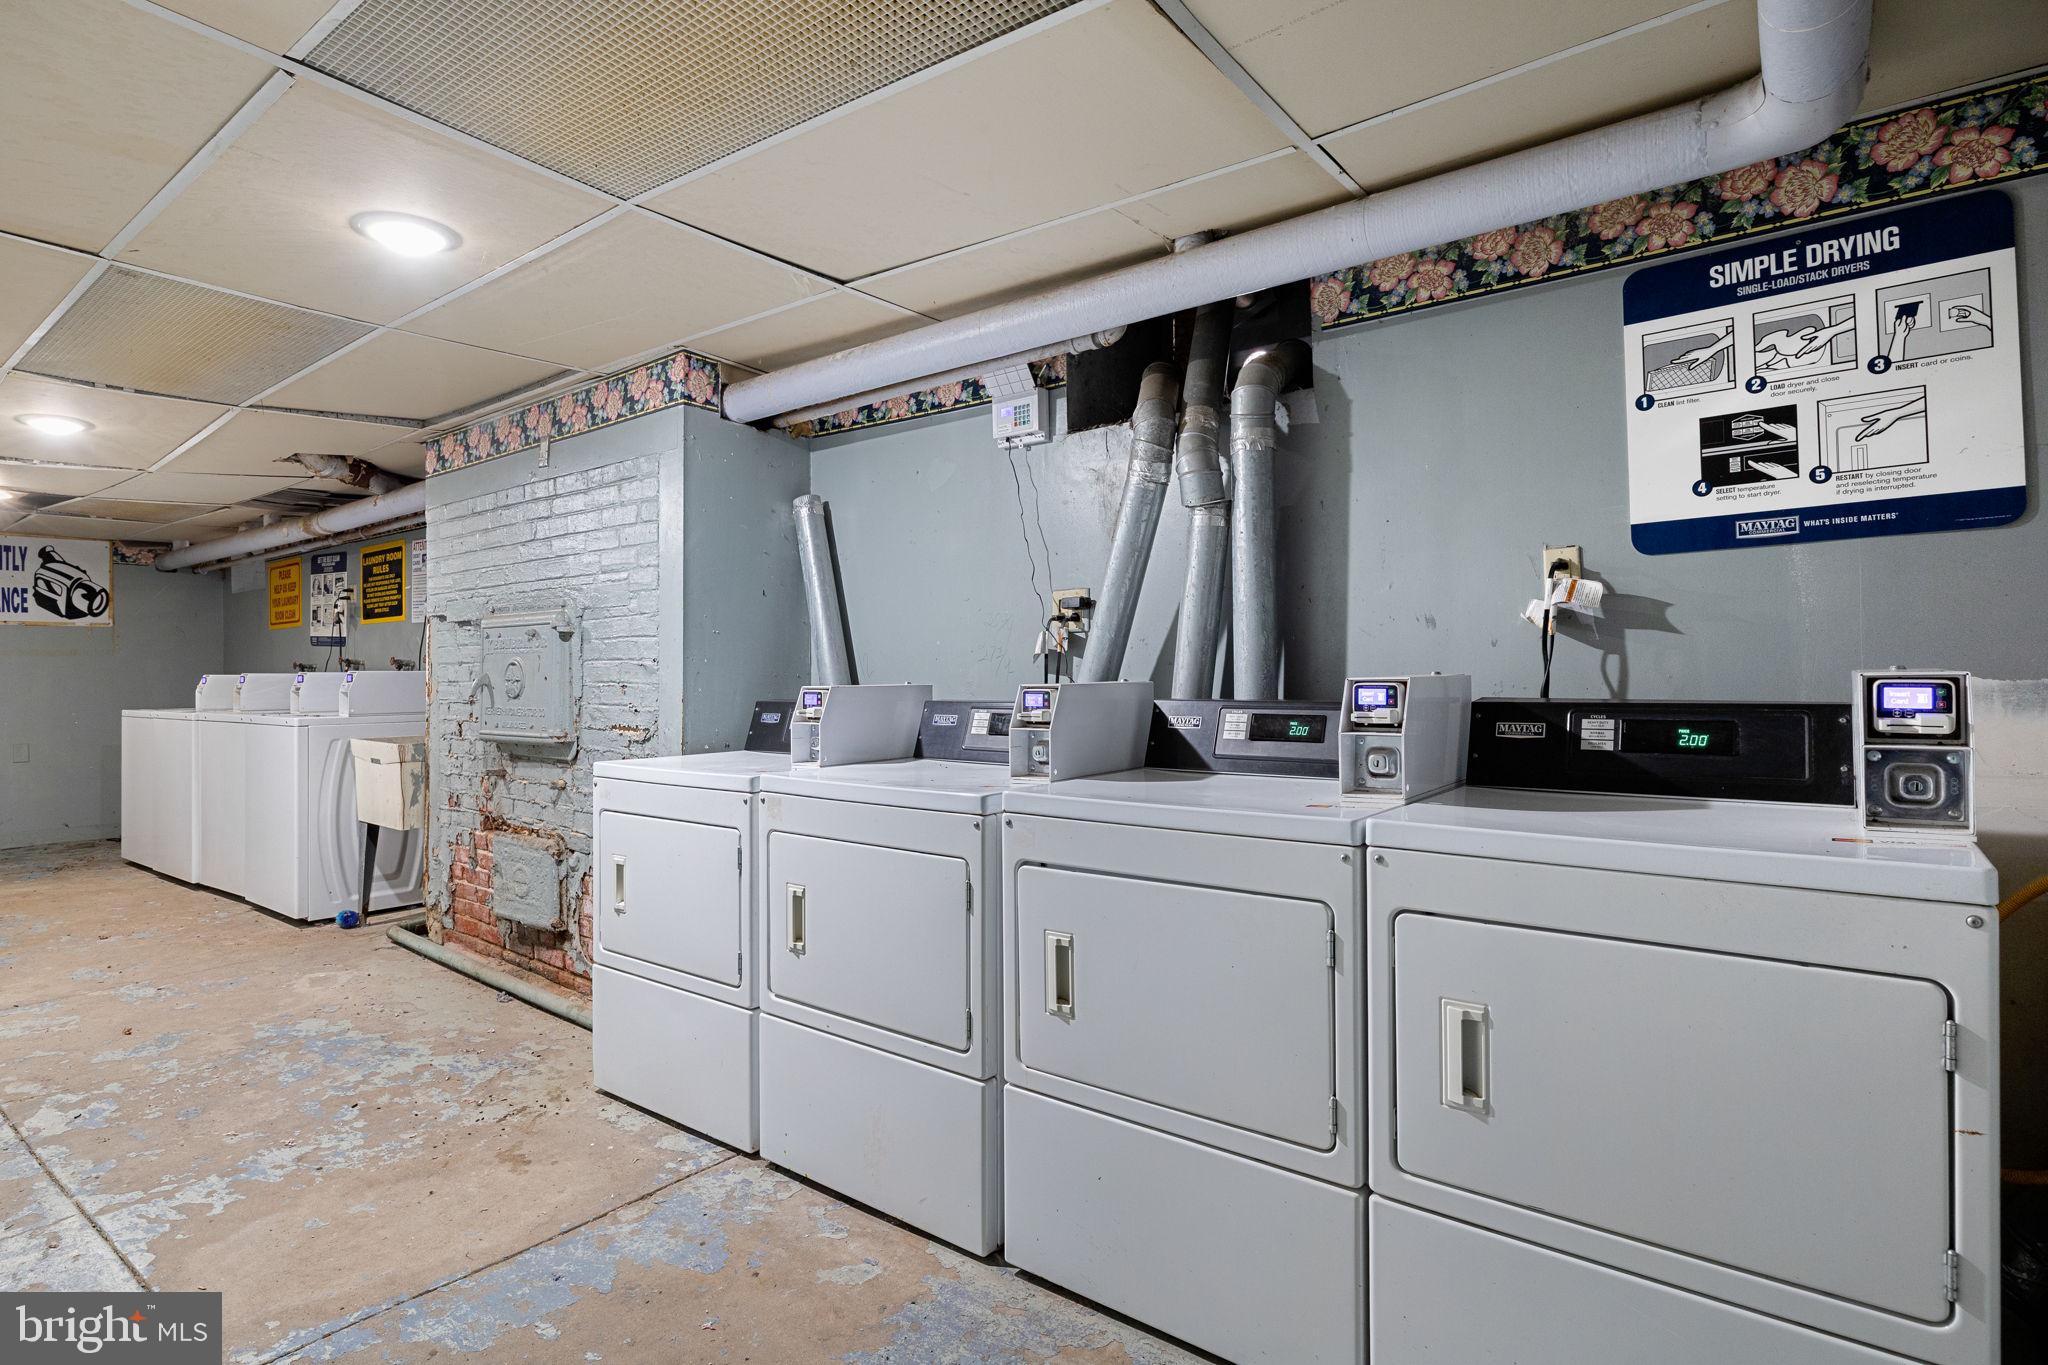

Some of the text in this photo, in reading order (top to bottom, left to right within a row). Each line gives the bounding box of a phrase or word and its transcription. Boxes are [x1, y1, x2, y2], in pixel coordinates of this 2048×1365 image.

[1709, 225, 1900, 288] SIMPLE DRYING
[1736, 260, 1870, 297] SINGLE-LOAD/STACK DRYERS
[1874, 358, 1885, 371] 3
[1895, 362, 1919, 371] INSERT
[1921, 359, 1938, 367] card
[1751, 375, 1840, 391] 2 LOAD dryer and close
[1770, 386, 1818, 398] door securely.
[1657, 400, 1675, 408] CLEAN
[1815, 468, 1826, 481] 5
[1835, 472, 1863, 481] RESTART
[1865, 472, 1874, 480] by
[1876, 469, 1902, 478] closing
[1851, 477, 1890, 487] reselecting
[1892, 473, 1938, 482] temperature
[1697, 482, 1776, 495] 4 SELECT temperature
[1842, 487, 1865, 496] drying
[1874, 482, 1916, 491] interrupted.
[1716, 494, 1738, 502] setting
[1740, 518, 1796, 533] MAYTAG
[1803, 517, 1830, 527] WHAT'S
[1832, 515, 1858, 524] INSIDE
[0, 545, 28, 572] TLY
[362, 554, 386, 567] LAUNDRY
[386, 550, 402, 562] ROOM
[372, 564, 390, 575] RULES
[0, 587, 29, 614] NCE
[1170, 716, 1200, 725] MAYTAG
[1289, 726, 1309, 736] 2.00
[1498, 724, 1543, 733] MAYTAG
[1679, 734, 1708, 746] 2.00
